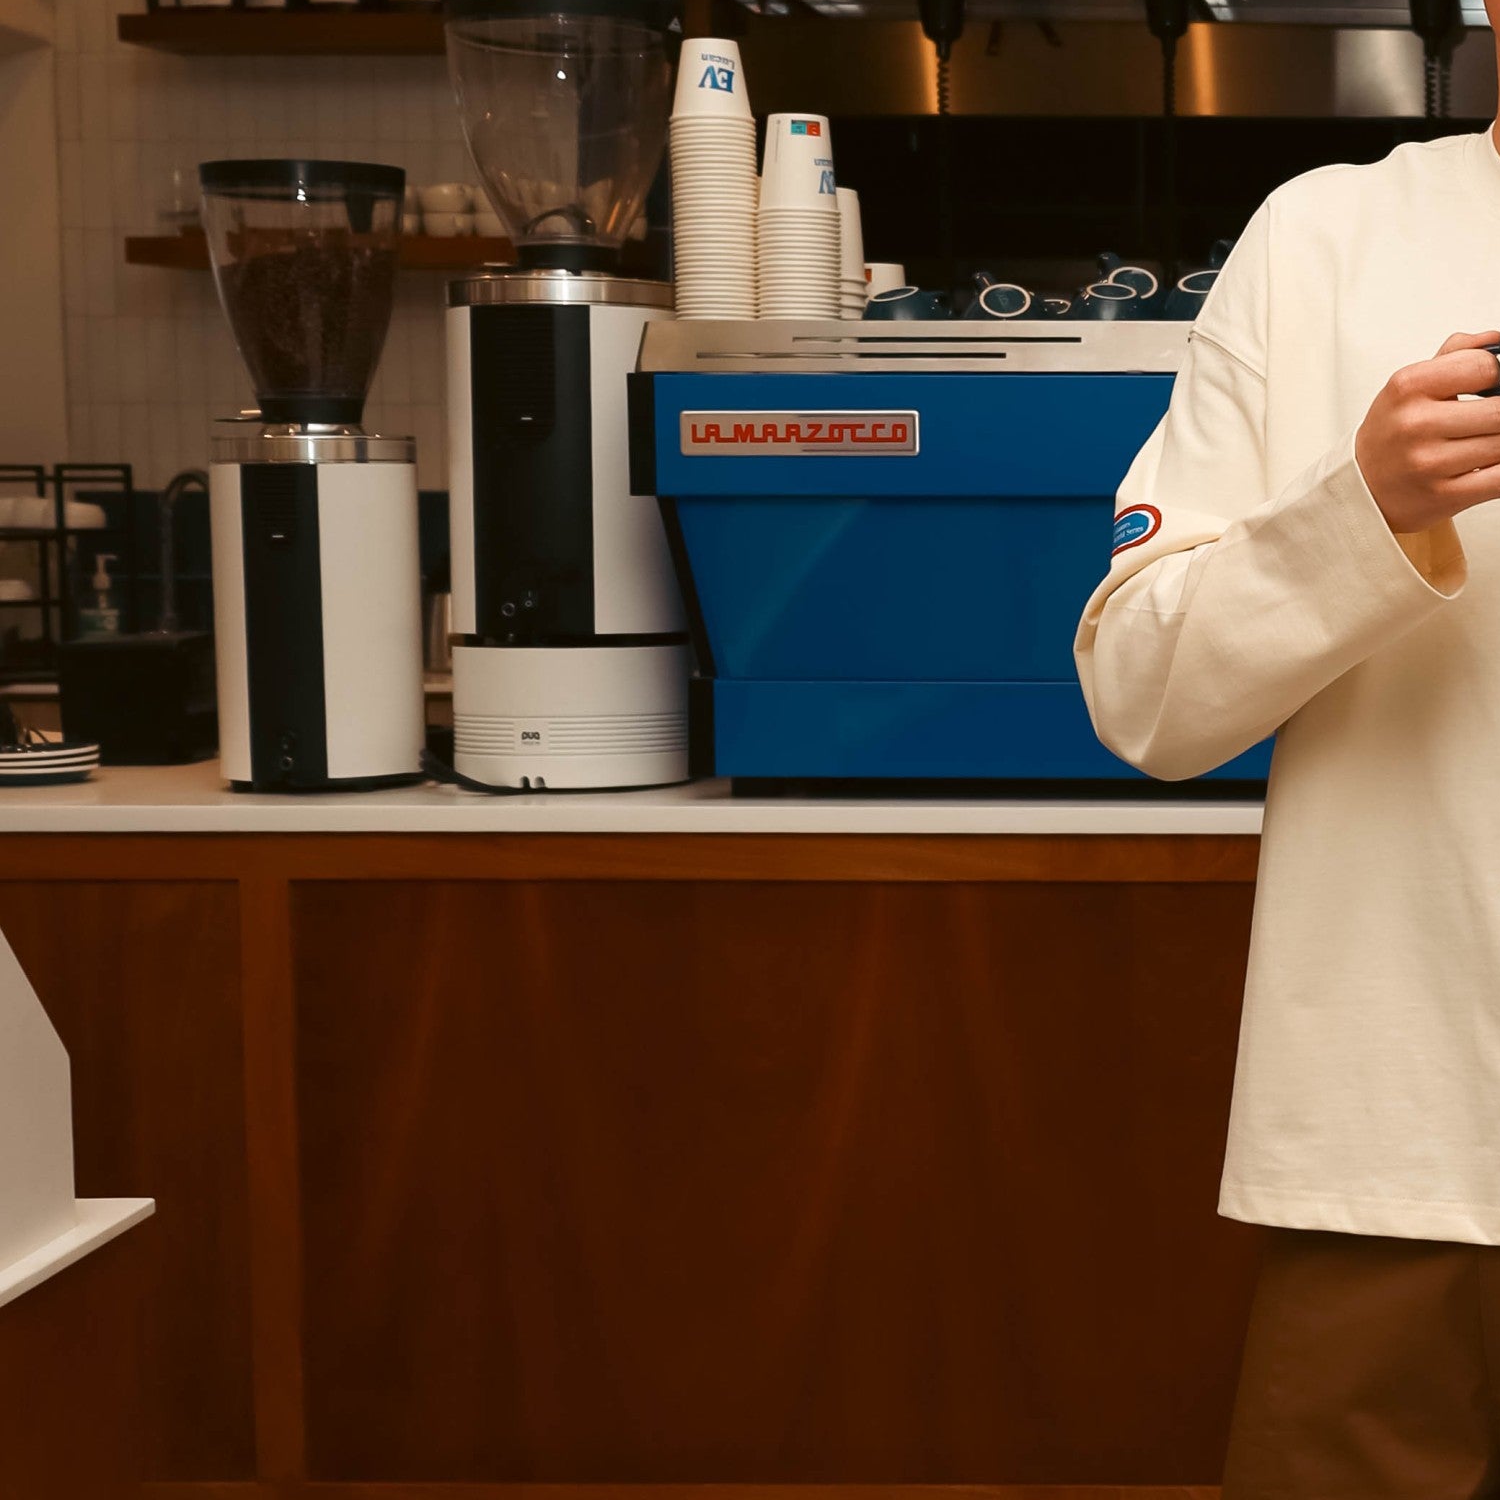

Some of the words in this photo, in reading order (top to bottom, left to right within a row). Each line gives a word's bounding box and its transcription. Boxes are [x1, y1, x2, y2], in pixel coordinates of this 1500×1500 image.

[701, 53, 735, 69] Lucan
[698, 65, 735, 93] EV
[691, 423, 721, 443] LA
